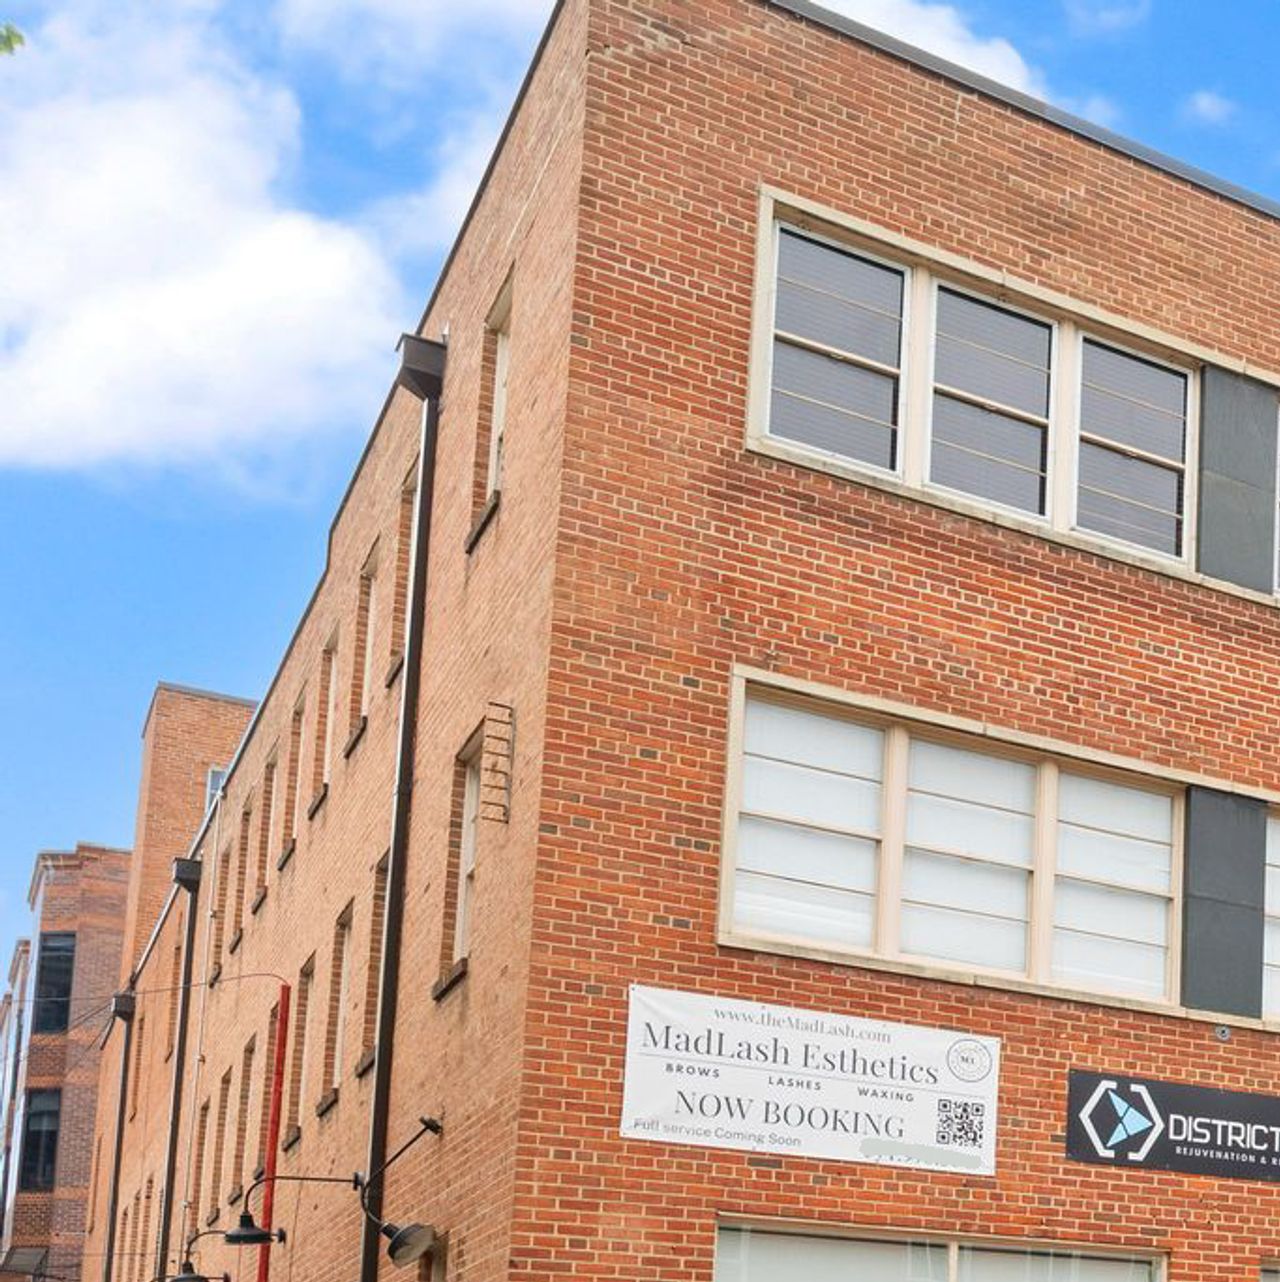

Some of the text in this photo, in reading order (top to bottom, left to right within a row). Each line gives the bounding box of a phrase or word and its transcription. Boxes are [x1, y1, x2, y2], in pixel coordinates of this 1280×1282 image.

[714, 1007, 892, 1044] www.theMadLash.com
[641, 1021, 789, 1066] MadLash
[803, 1043, 940, 1085] Esthetics
[665, 1062, 915, 1102] BROWS LASHES WAXING
[633, 1117, 802, 1147] Full service Coming Soon
[674, 1090, 904, 1139] NOW BOOKING
[1175, 1145, 1256, 1164] REJUVENATION
[1260, 1155, 1268, 1165] &
